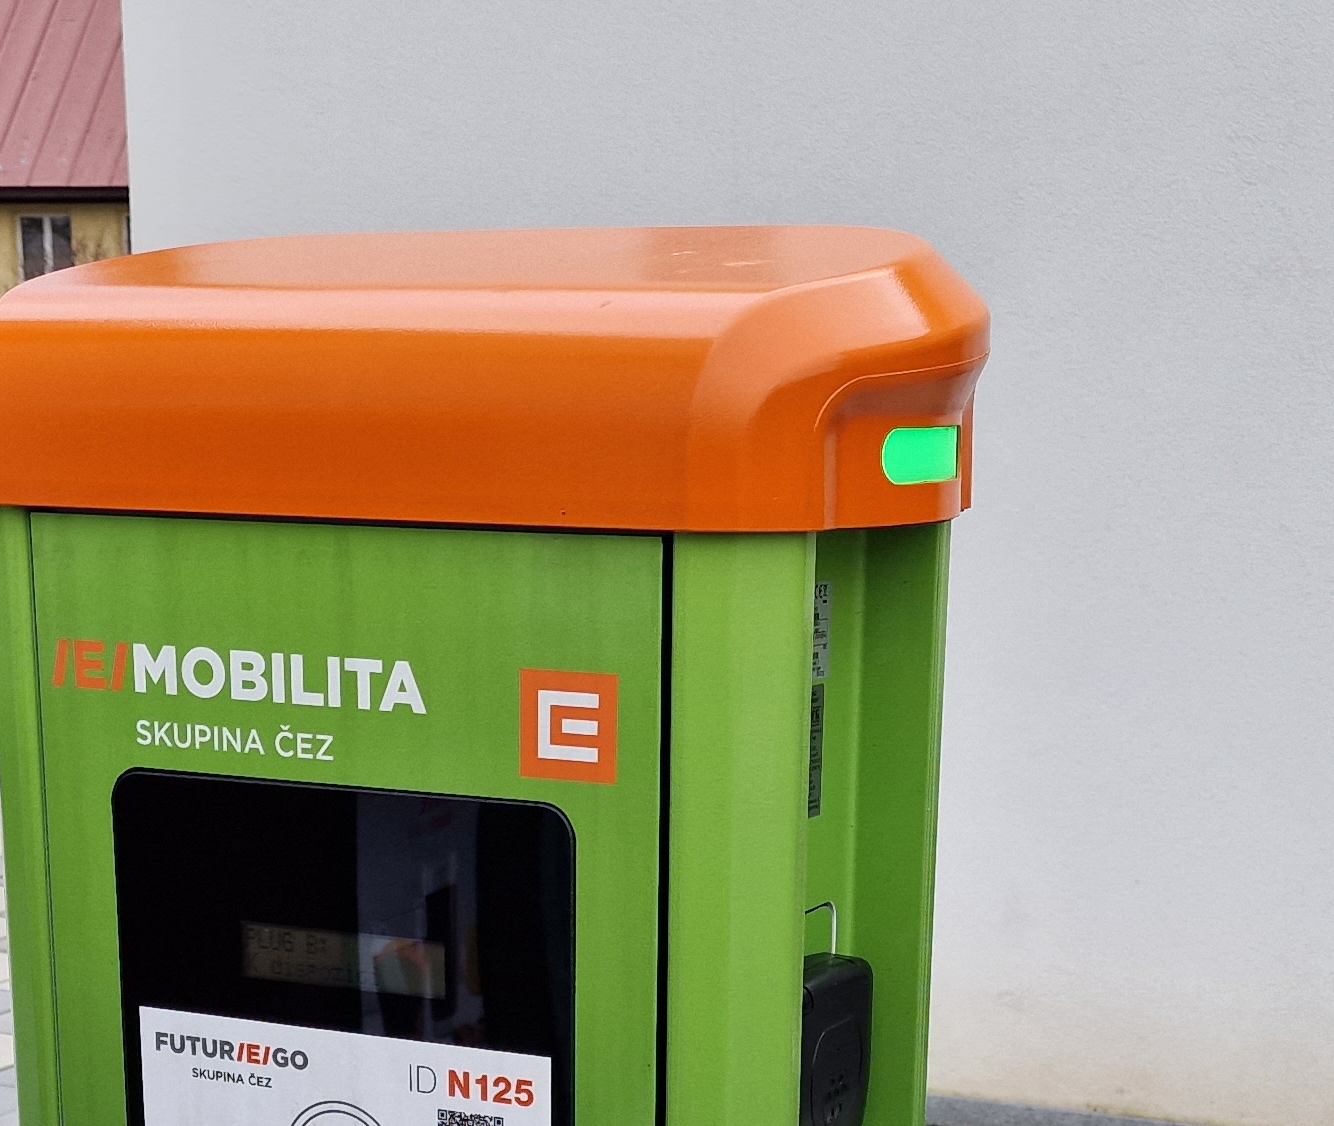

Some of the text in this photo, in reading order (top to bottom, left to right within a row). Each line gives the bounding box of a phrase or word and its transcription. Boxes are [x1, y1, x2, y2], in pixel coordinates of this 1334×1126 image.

[135, 719, 335, 762] SKUPINA ČEZ
[155, 1031, 309, 1071] FUTUR/E/GO
[191, 1067, 273, 1089] SKUPINA ČEZ
[408, 1063, 535, 1107] ID N125
